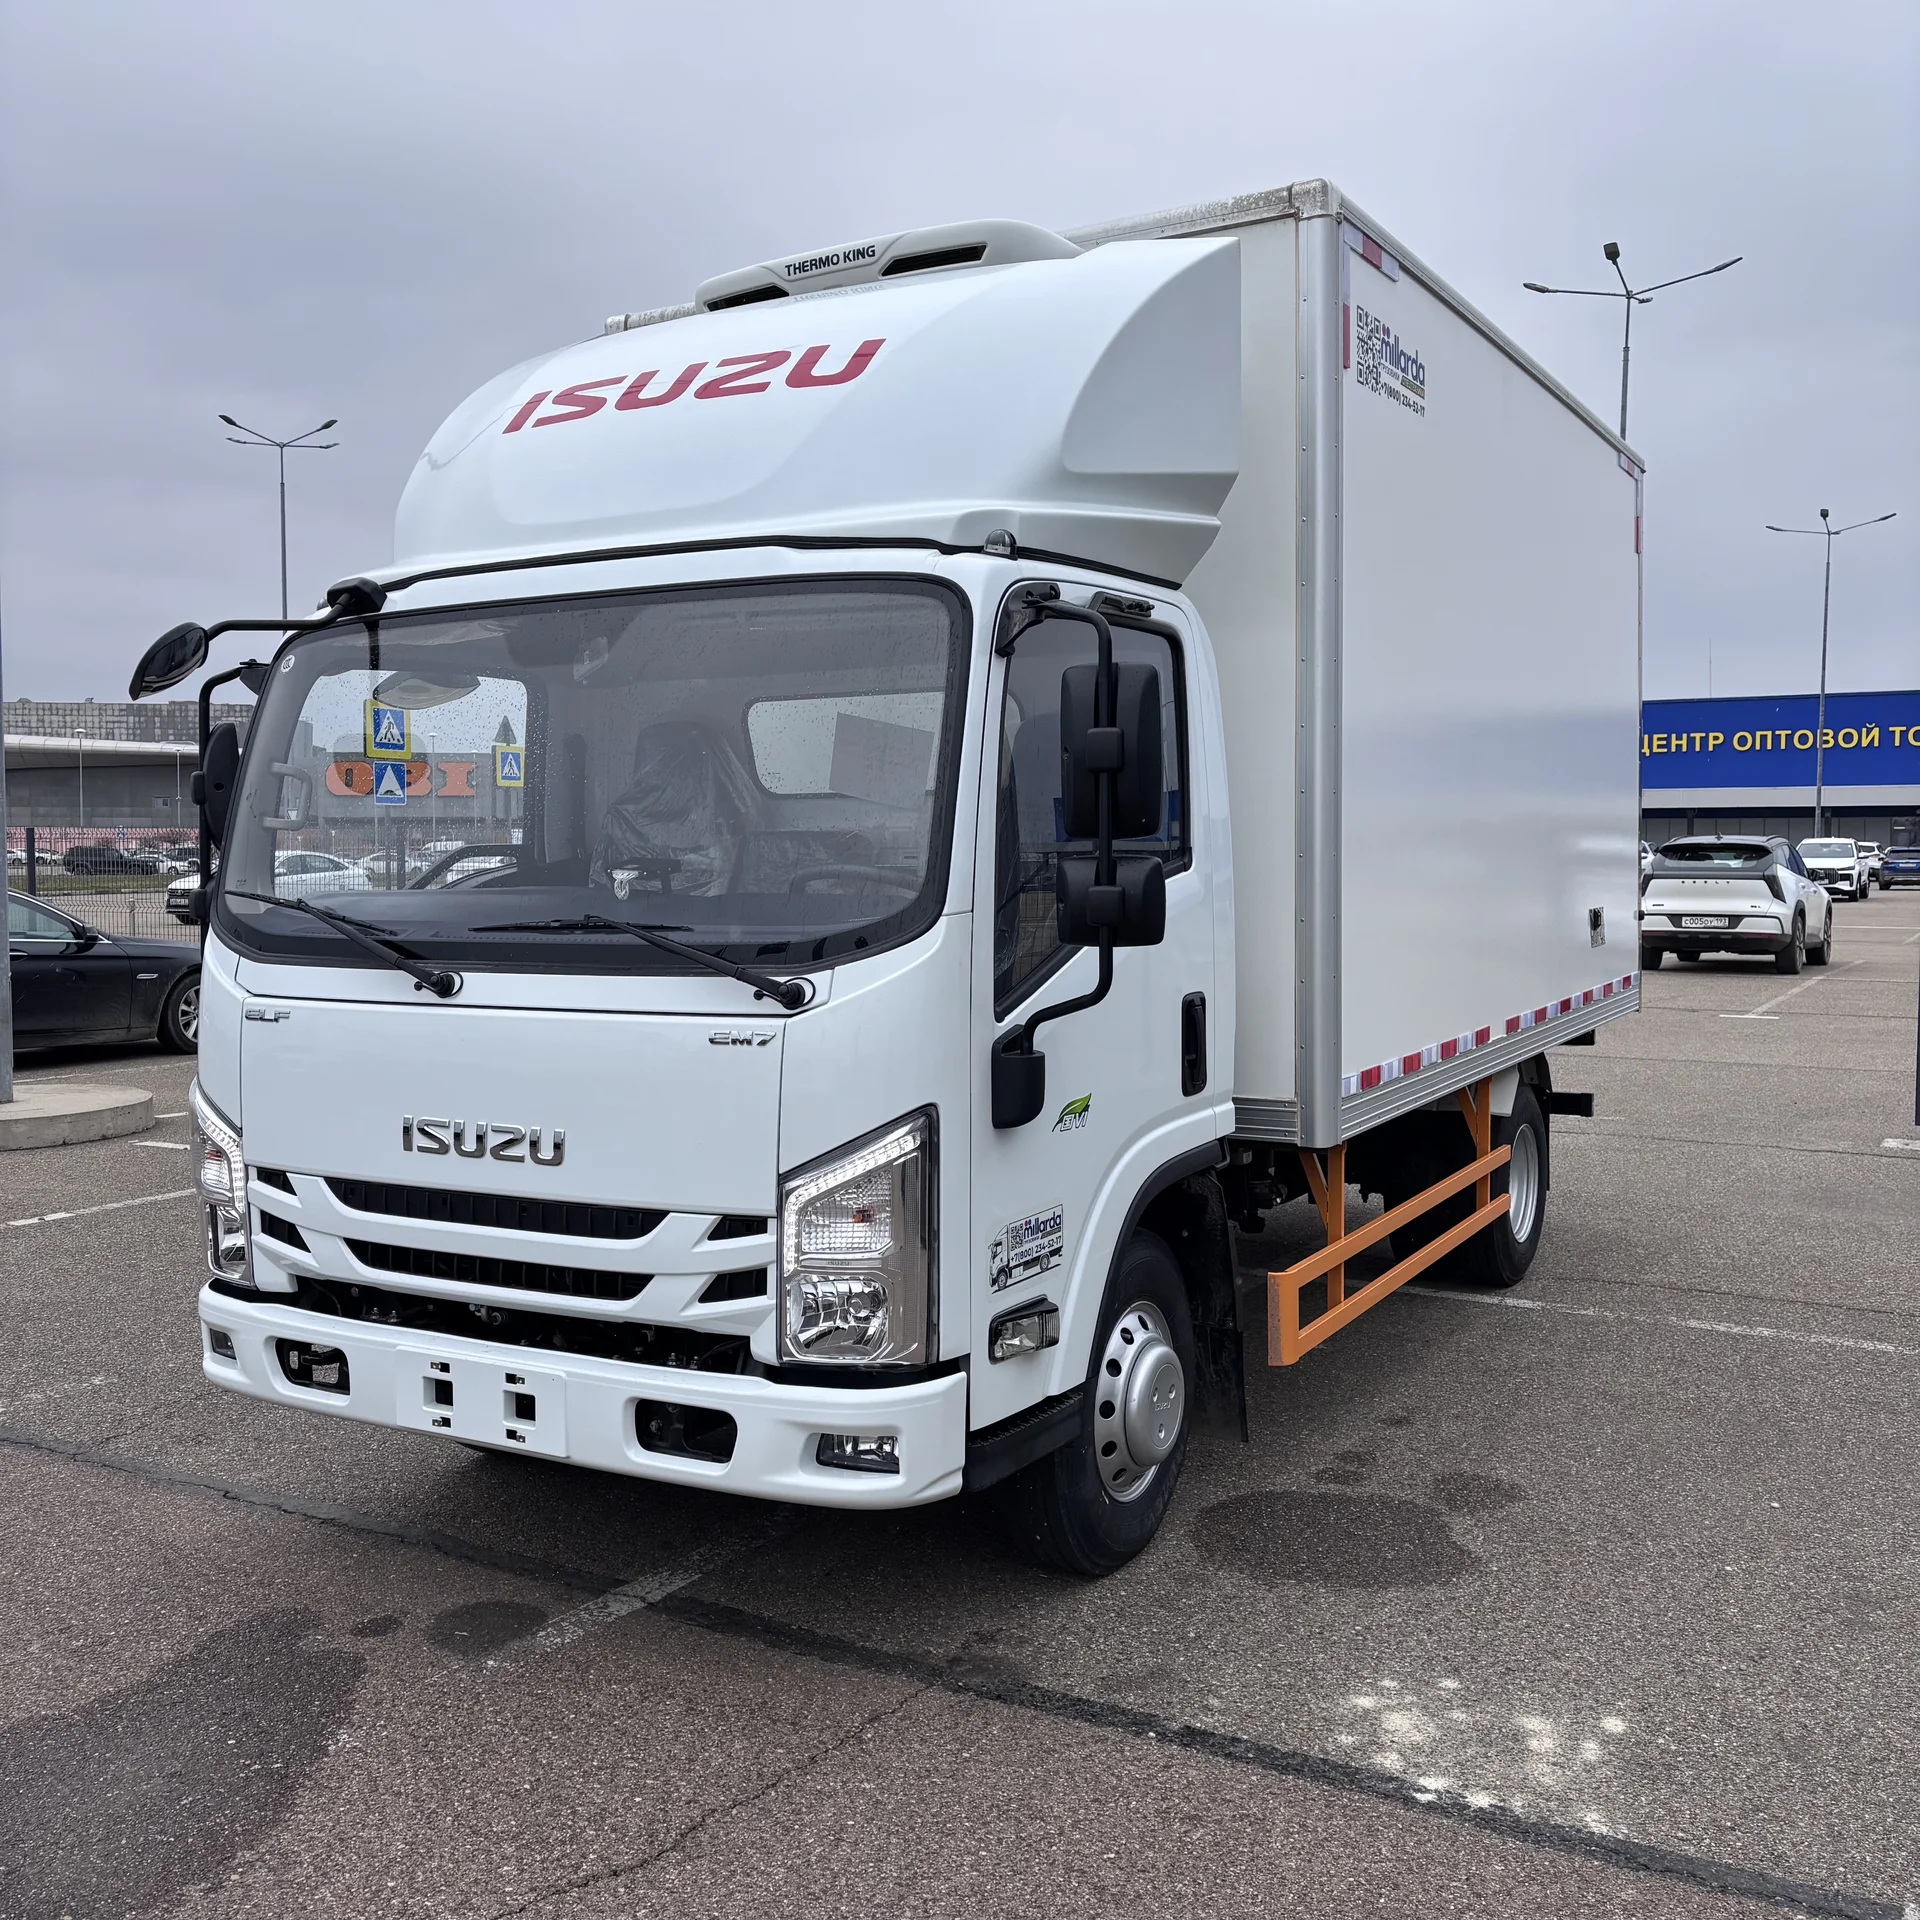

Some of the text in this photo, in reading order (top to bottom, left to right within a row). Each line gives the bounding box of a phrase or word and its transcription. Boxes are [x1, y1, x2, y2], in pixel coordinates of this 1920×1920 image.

[785, 245, 876, 276] THERMO KING
[1380, 324, 1425, 387] millarda
[502, 338, 886, 434] ISUZU
[1733, 722, 1880, 751] ОПТОВОЙ
[245, 1008, 291, 1023] ELF
[708, 1030, 777, 1046] EM7
[402, 1115, 566, 1167] ISUZU
[1023, 1210, 1062, 1240] millarda
[1010, 1246, 1034, 1263] +7(800)
